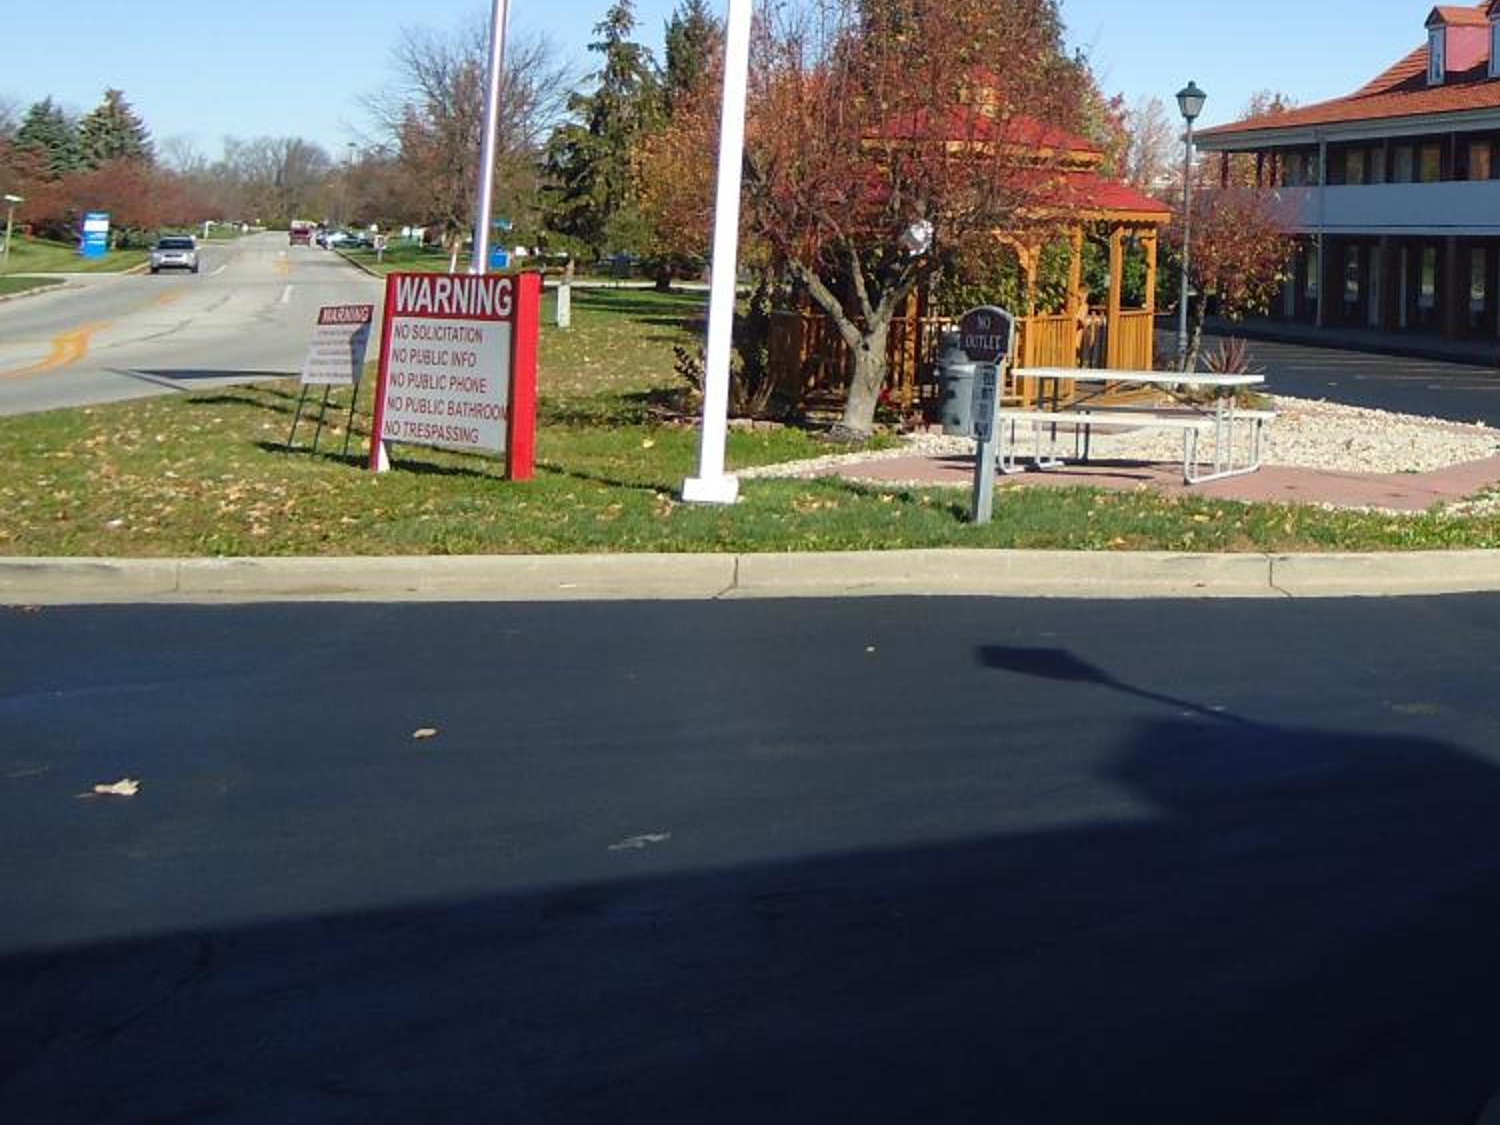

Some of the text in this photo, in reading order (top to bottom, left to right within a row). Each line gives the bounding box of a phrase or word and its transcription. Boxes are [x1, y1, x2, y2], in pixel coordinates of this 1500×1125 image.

[396, 276, 512, 316] WARNING
[321, 305, 369, 324] WARNING
[977, 315, 991, 330] NO
[395, 325, 483, 344] NO SOLICITATION
[965, 335, 1000, 348] OUTLET
[391, 348, 477, 368] NO PUBLIC INFO
[389, 372, 487, 394] NO PUBLIC PHONE
[387, 396, 402, 412] NO
[405, 397, 445, 416] PUBLIC
[384, 420, 479, 444] NO TRESPASSING
